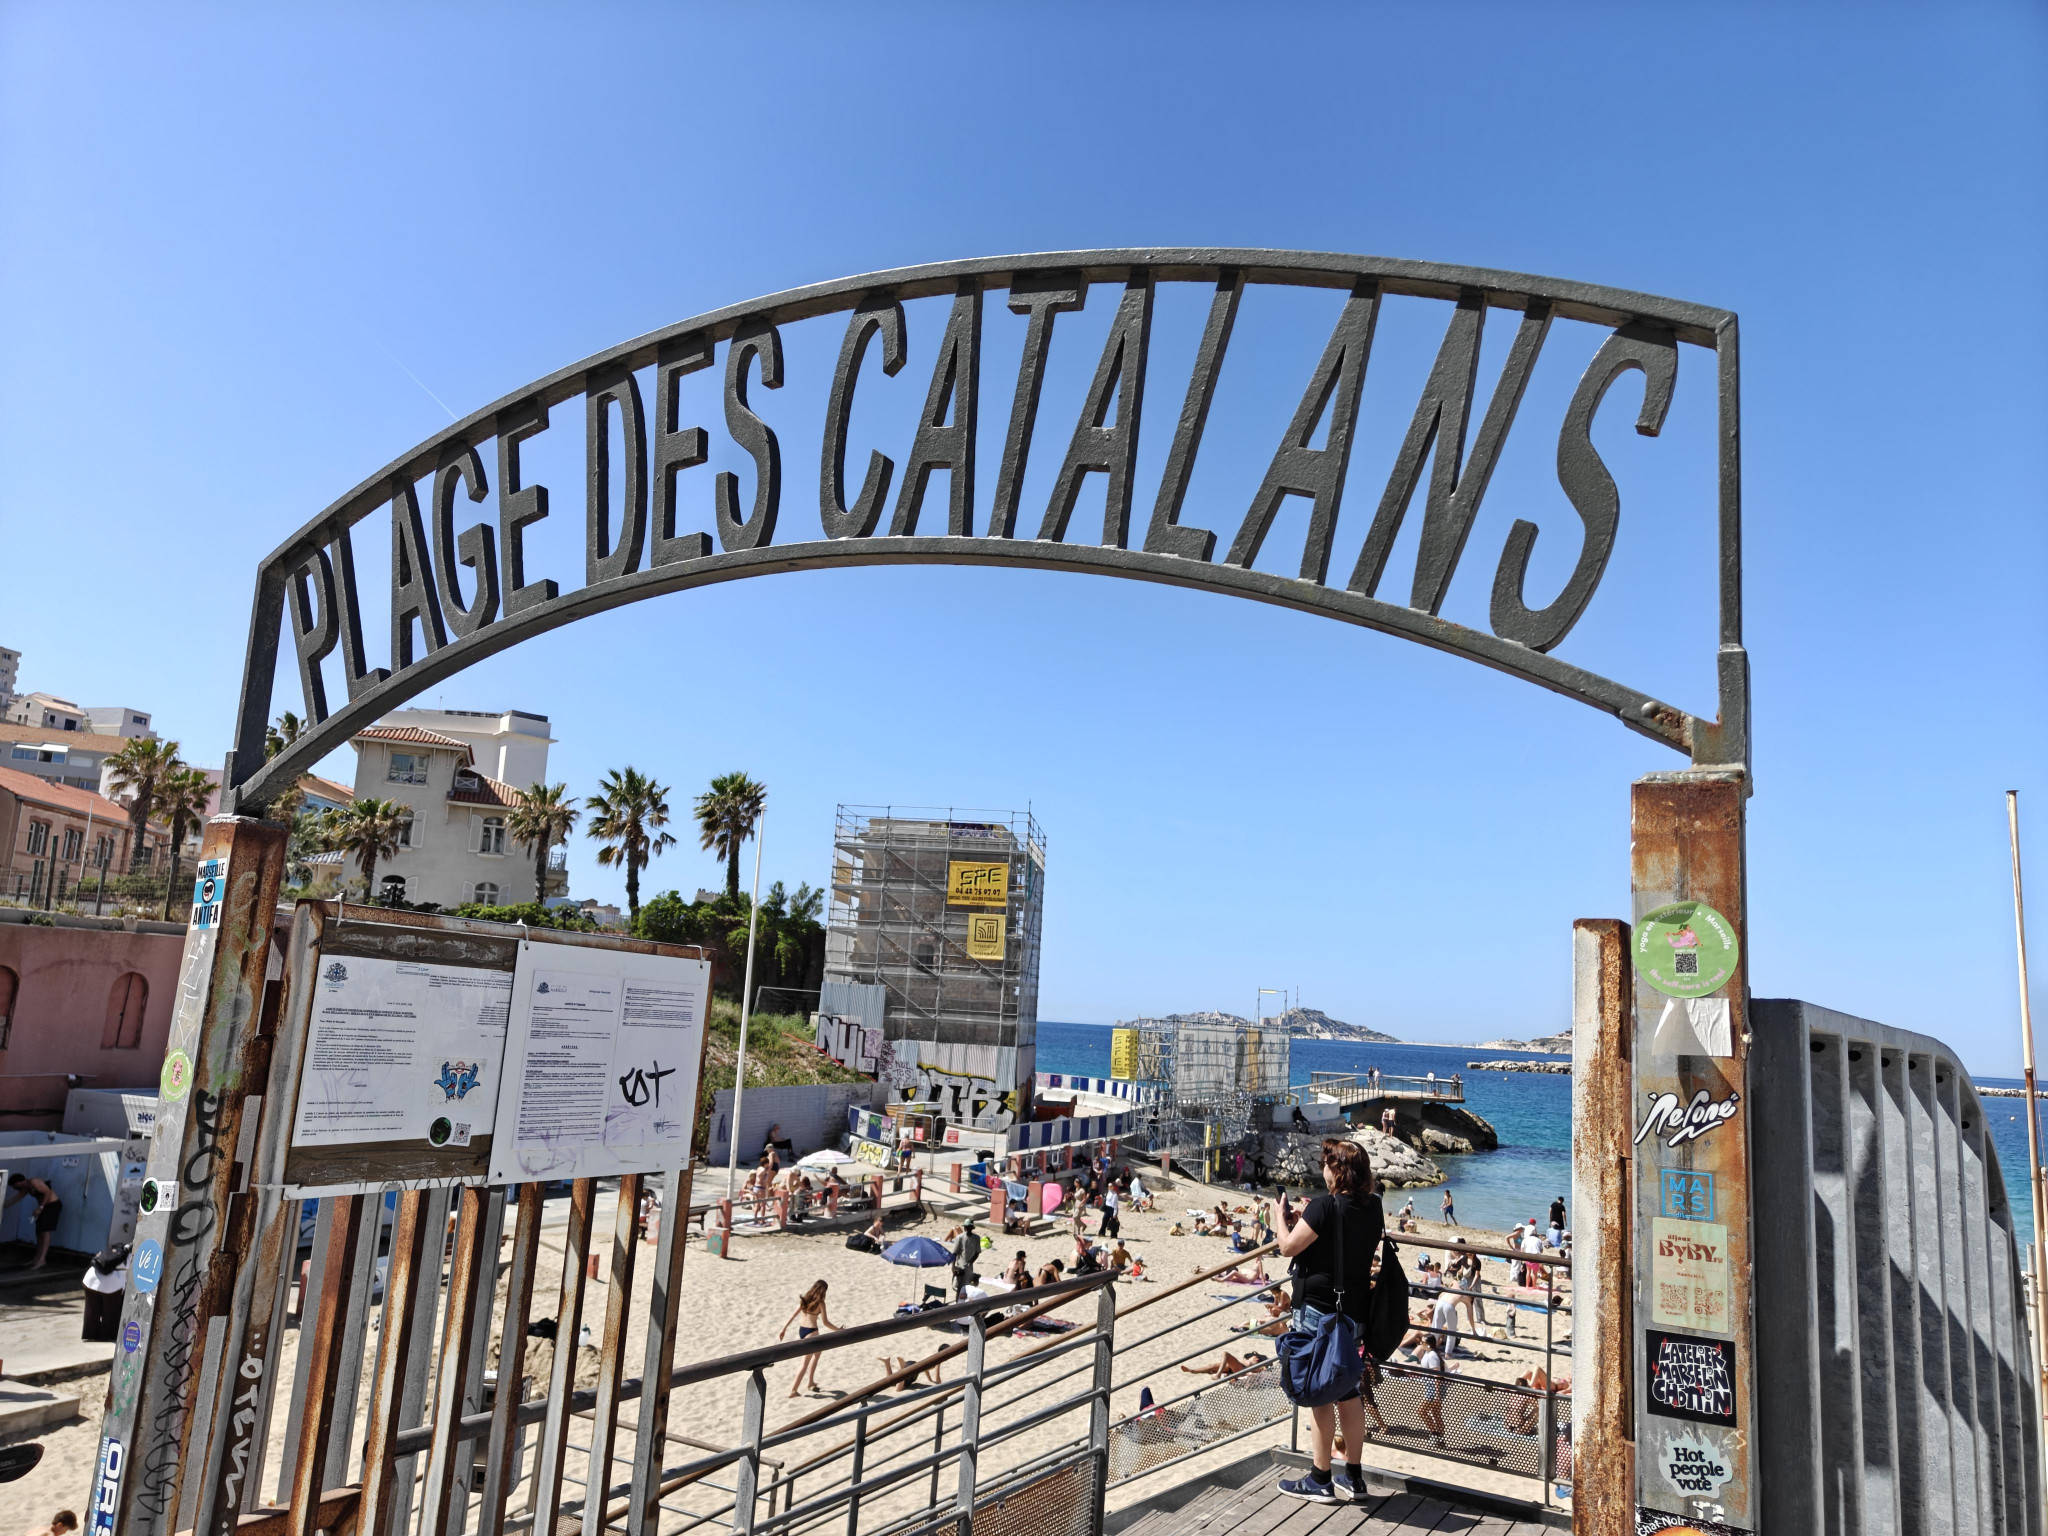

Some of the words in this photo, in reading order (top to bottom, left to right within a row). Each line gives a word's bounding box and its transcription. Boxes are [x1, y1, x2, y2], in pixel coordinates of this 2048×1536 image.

[286, 400, 559, 727] PLAGE
[585, 315, 785, 586] DES
[818, 266, 1679, 652] CATALANS
[197, 863, 225, 879] MARSEILLE
[193, 904, 219, 926] ANTIFA
[1640, 933, 1649, 952] yoga
[1646, 921, 1655, 931] en
[1705, 914, 1732, 950] Marseille
[1673, 1447, 1706, 1462] Hot
[97, 1462, 105, 1495] DROIT
[1669, 1461, 1725, 1480] people
[1675, 1478, 1712, 1491] vote
[94, 1495, 101, 1511] AU
[90, 1514, 98, 1533] BUT
